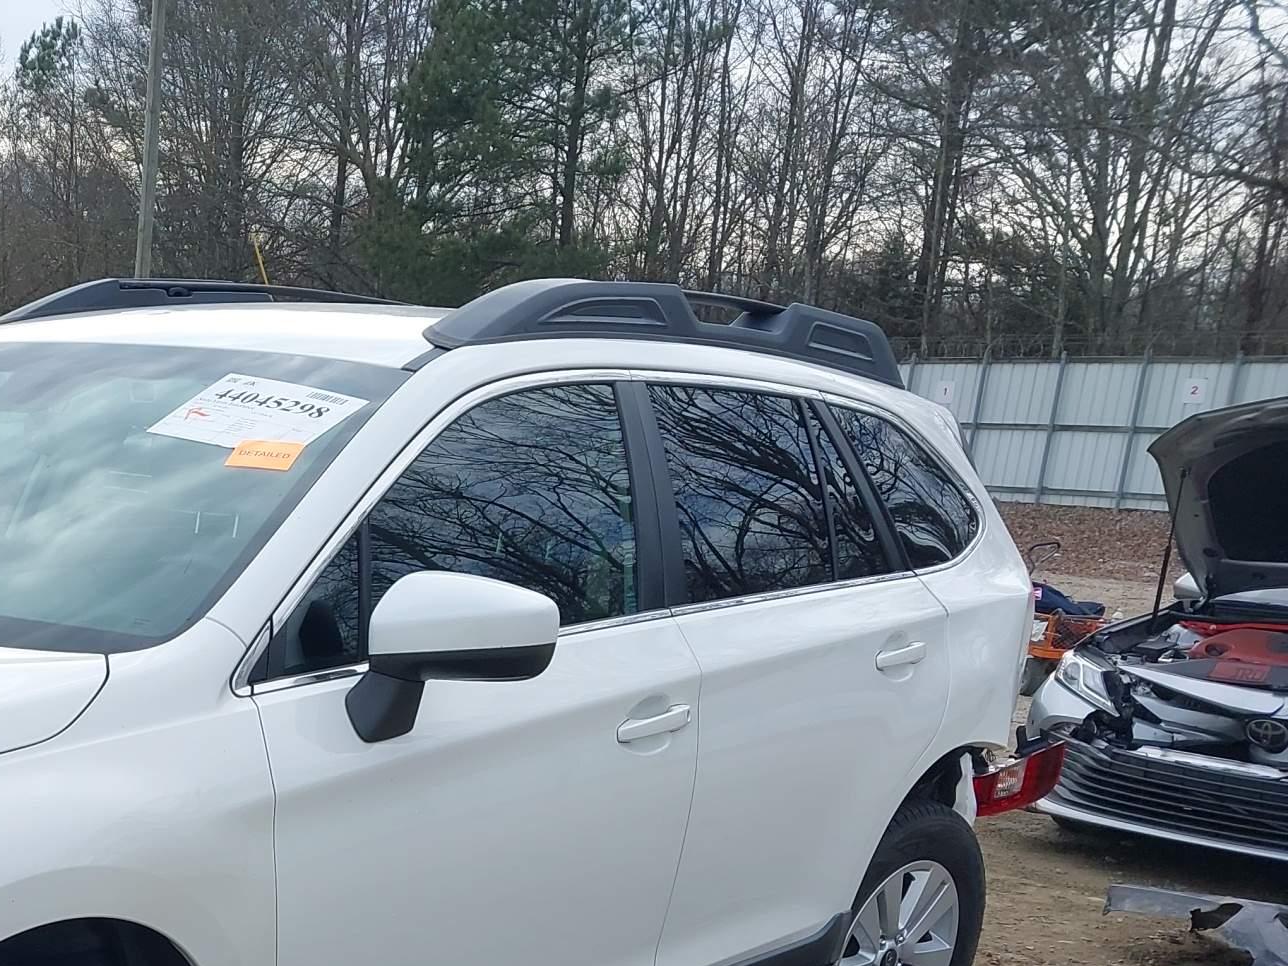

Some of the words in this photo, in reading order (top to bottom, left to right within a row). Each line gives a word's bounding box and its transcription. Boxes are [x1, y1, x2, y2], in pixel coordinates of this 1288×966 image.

[1191, 385, 1199, 395] 2
[215, 388, 330, 418] 44045298
[238, 449, 291, 459] DETAILED
